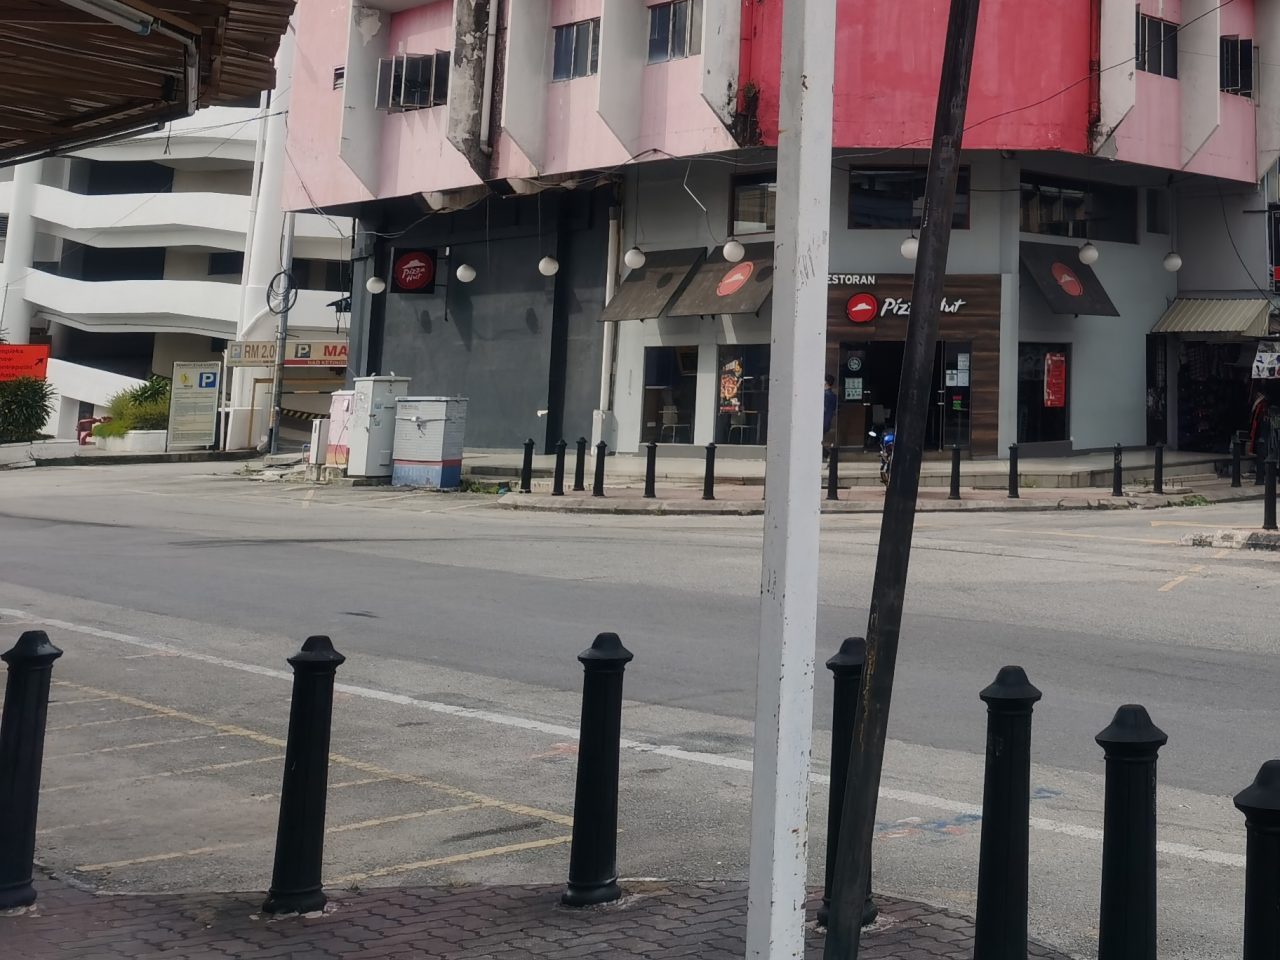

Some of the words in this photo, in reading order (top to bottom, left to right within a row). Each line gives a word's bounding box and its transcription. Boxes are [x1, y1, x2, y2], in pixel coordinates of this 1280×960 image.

[406, 273, 422, 283] Hut
[827, 274, 876, 285] ESTORAN
[880, 297, 912, 317] Piz
[244, 344, 260, 359] RM
[261, 344, 276, 359] 2.0
